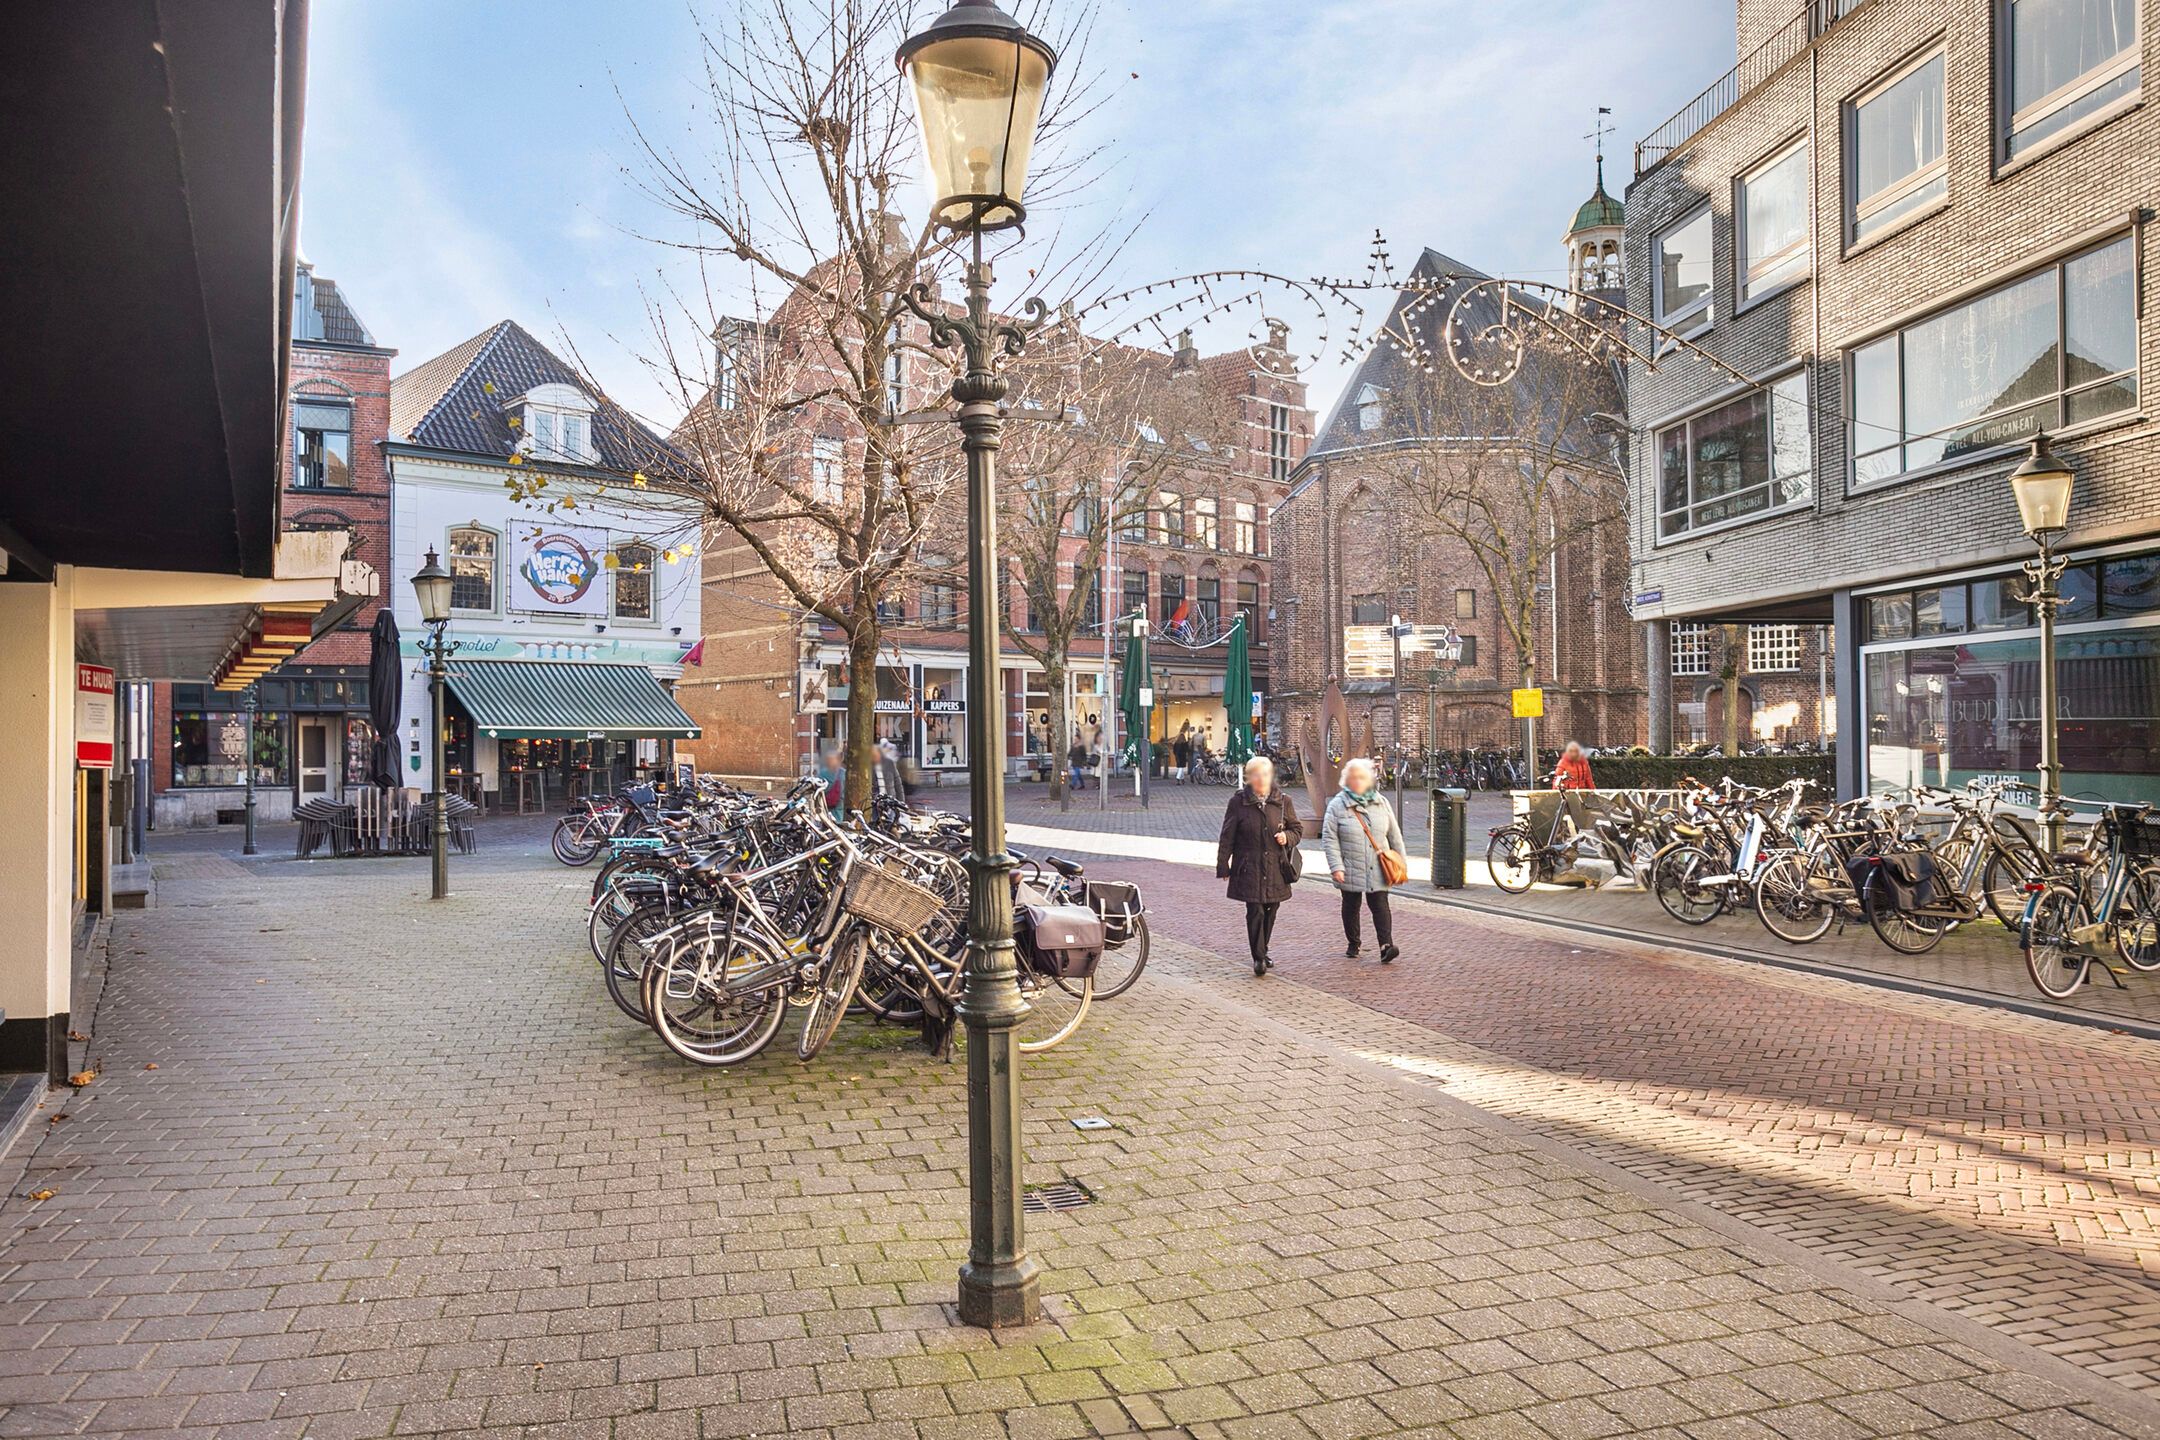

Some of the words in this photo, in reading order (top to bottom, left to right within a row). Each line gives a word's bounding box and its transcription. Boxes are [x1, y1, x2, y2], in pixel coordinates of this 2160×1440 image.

[1971, 415, 2035, 446] ALL-YOU-CAN-EAT
[81, 669, 92, 687] TE
[93, 671, 113, 690] HUUR
[930, 701, 960, 710] KAPPERS
[1951, 697, 2026, 723] BUDDHA
[2032, 695, 2073, 720] BR
[1977, 774, 1997, 787] NEXT
